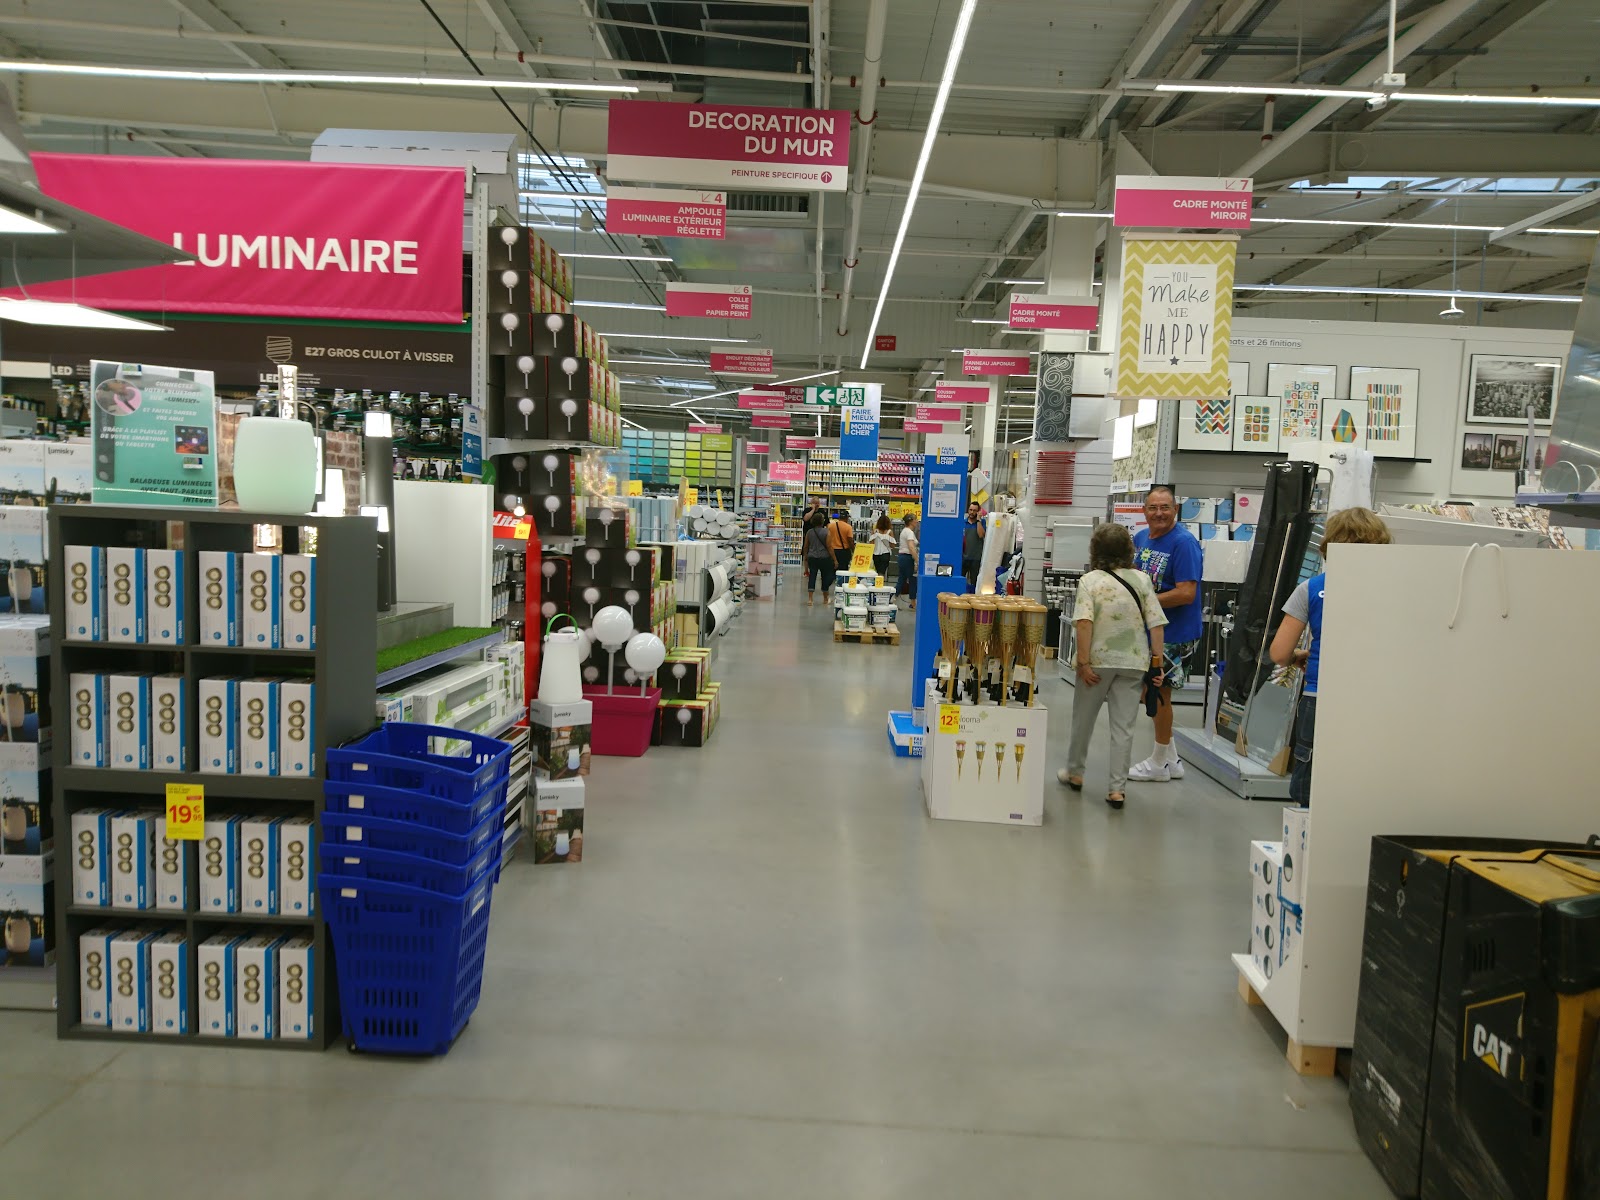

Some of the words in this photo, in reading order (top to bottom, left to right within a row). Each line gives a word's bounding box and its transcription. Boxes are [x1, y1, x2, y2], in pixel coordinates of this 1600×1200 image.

[688, 110, 835, 135] DECORATION
[744, 135, 777, 155] DU
[783, 137, 833, 157] MUR
[731, 169, 770, 178] PEINTURE
[771, 171, 818, 181] SPECIFIQUE
[1240, 179, 1249, 190] 7
[714, 193, 723, 203] 4
[1172, 200, 1208, 209] CADRE
[1210, 199, 1248, 210] MONTÉ
[677, 206, 722, 217] AMPOULE
[1210, 211, 1247, 220] MIROIR
[622, 213, 671, 223] LUMINAIRE
[673, 214, 722, 226] EXTÉRIEUR
[676, 225, 722, 236] RÉGLETTE
[172, 232, 419, 275] LUMINAIRE
[1171, 271, 1188, 283] YOU
[743, 286, 749, 294] 6
[1147, 283, 1211, 303] Make
[1036, 309, 1060, 317] MONTÉ
[1167, 307, 1188, 318] ME
[1143, 323, 1209, 355] HAPPY
[1269, 340, 1301, 348] finitions
[305, 346, 325, 357] E27
[327, 348, 361, 359] GROS
[362, 349, 400, 361] CULOT
[403, 350, 412, 361] À
[414, 352, 454, 363] VISSER
[51, 365, 73, 375] LED
[259, 373, 280, 383] LED
[850, 423, 874, 431] MOINS
[129, 477, 171, 486] BALADEUSE
[172, 478, 213, 487] LUMINEUSE
[959, 715, 981, 724] looma
[1472, 1023, 1512, 1078] CAT
